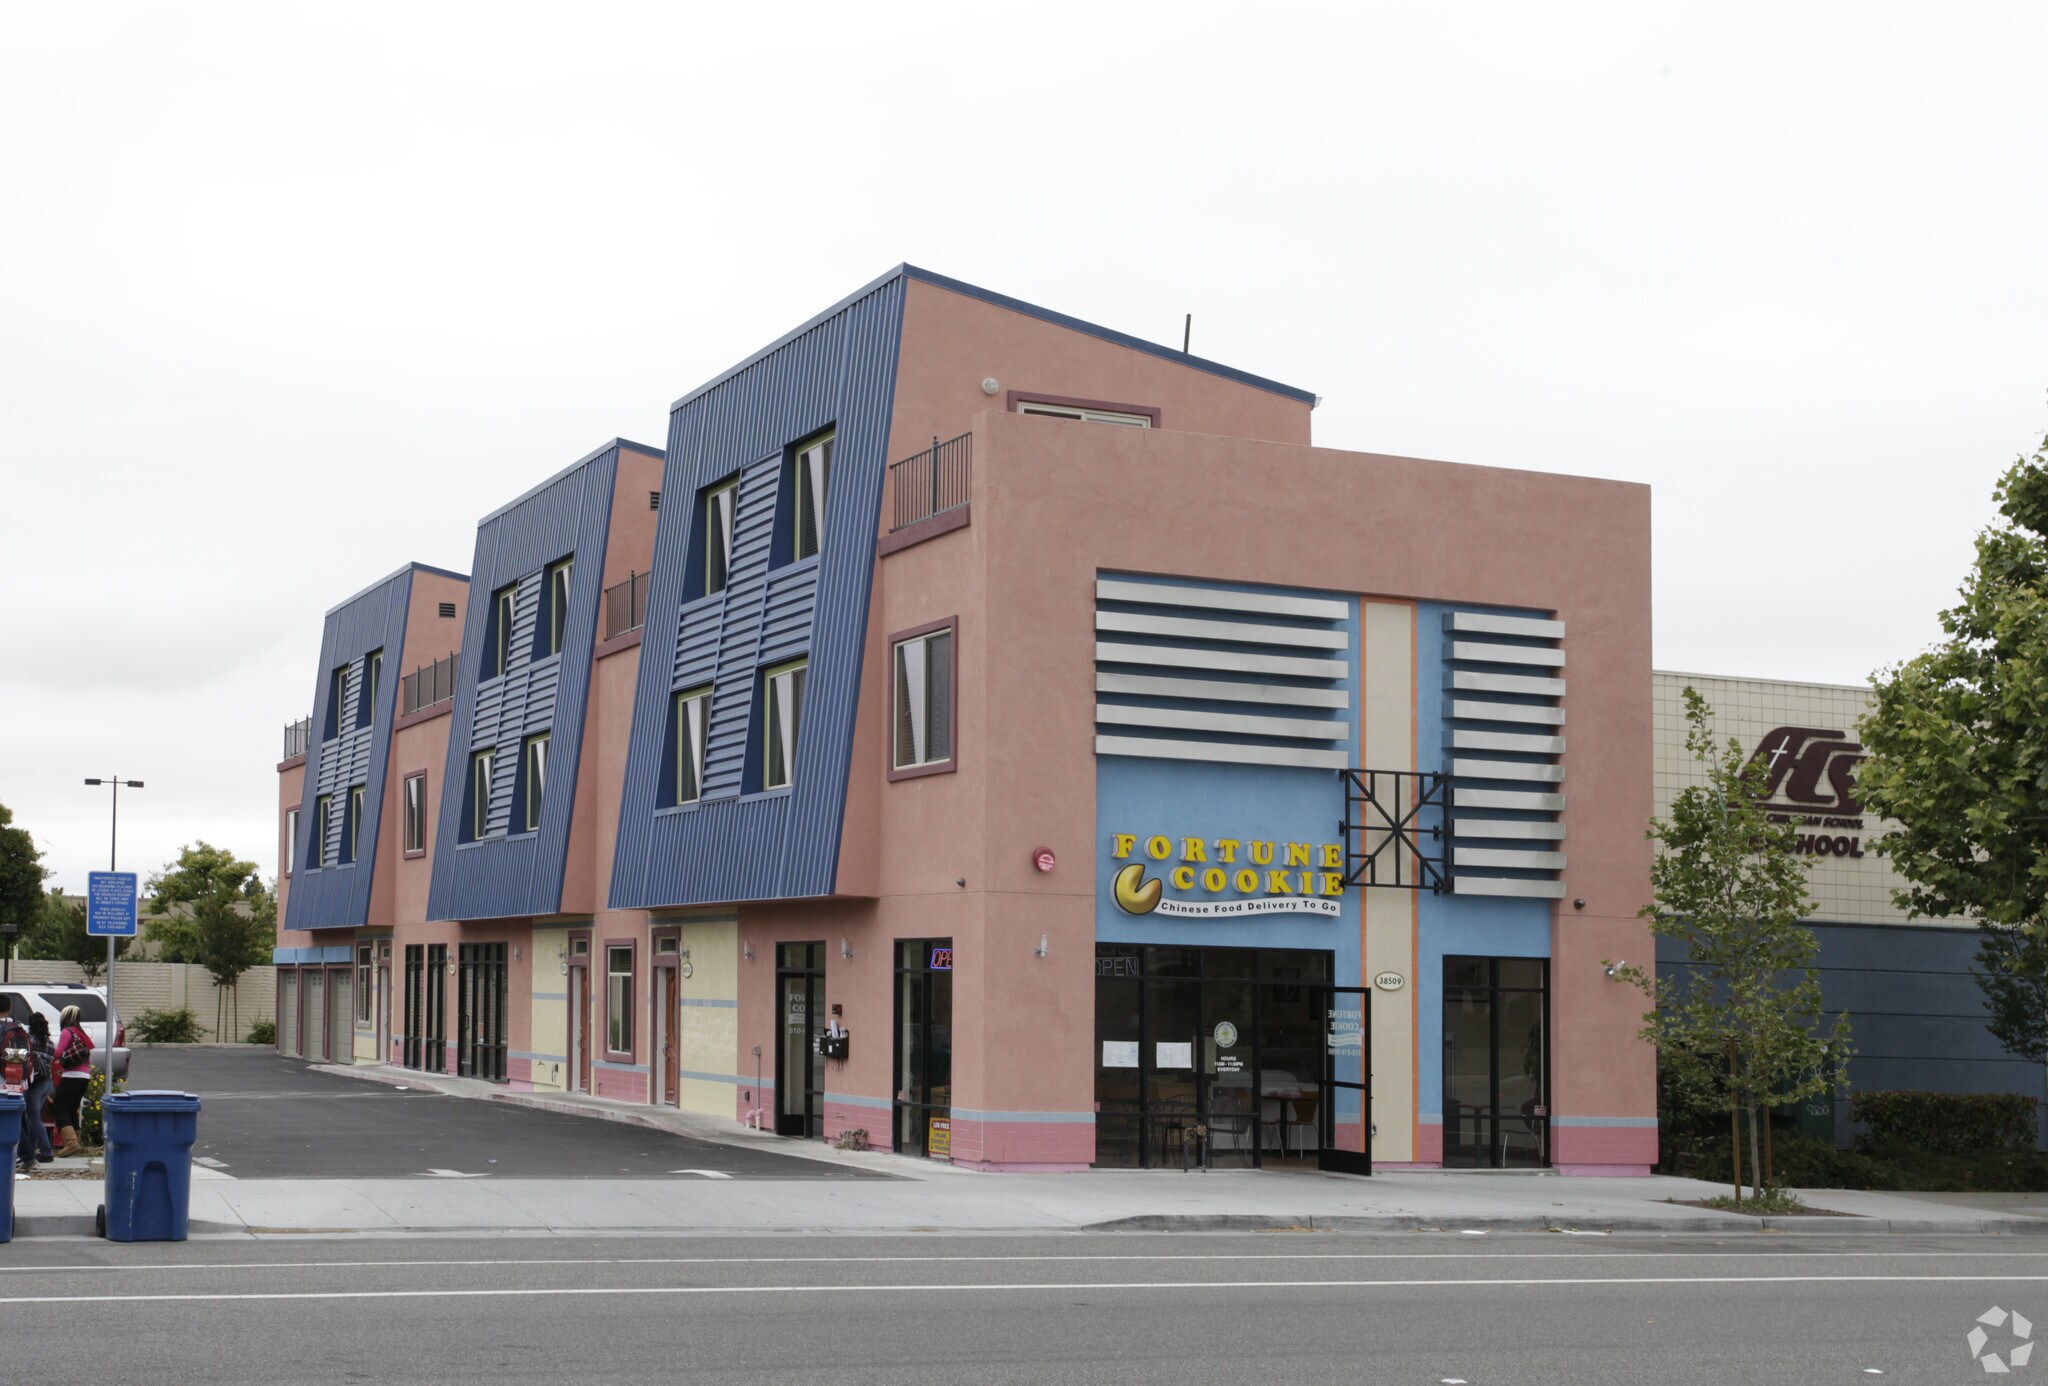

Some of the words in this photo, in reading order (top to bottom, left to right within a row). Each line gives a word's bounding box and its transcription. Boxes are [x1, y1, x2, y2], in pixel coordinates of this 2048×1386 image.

[1822, 816, 1864, 829] SCHOOL
[1111, 833, 1343, 868] FORTUNE
[1168, 865, 1344, 896] COOKIE
[1161, 902, 1209, 914] Chinese
[1214, 904, 1242, 913] Food
[1247, 901, 1297, 911] Delivery
[1302, 900, 1316, 909] To
[1321, 902, 1336, 912] Go
[1379, 977, 1402, 985] 38509
